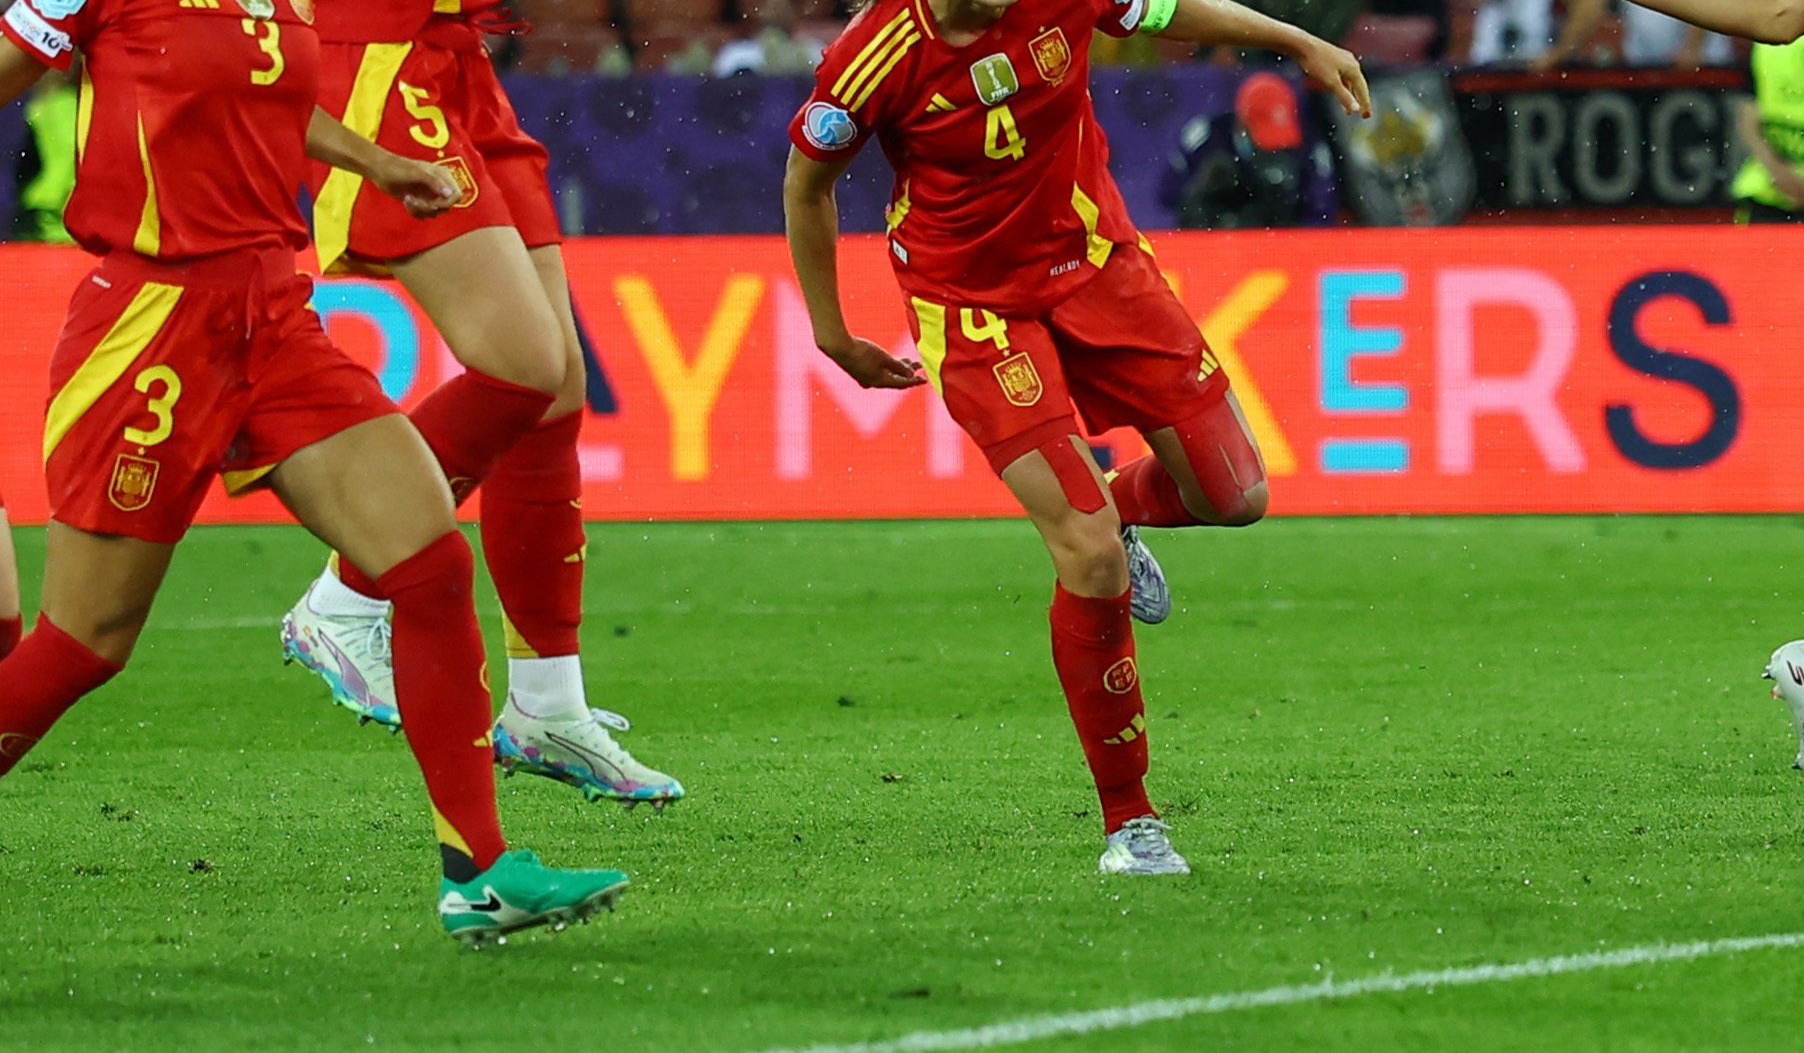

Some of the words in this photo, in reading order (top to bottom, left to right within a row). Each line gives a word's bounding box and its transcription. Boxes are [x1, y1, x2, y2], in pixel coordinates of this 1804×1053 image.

[240, 18, 286, 86] 3
[398, 80, 451, 150] 5
[984, 104, 1027, 162] 4
[960, 307, 1011, 351] 4
[123, 364, 183, 447] 3
